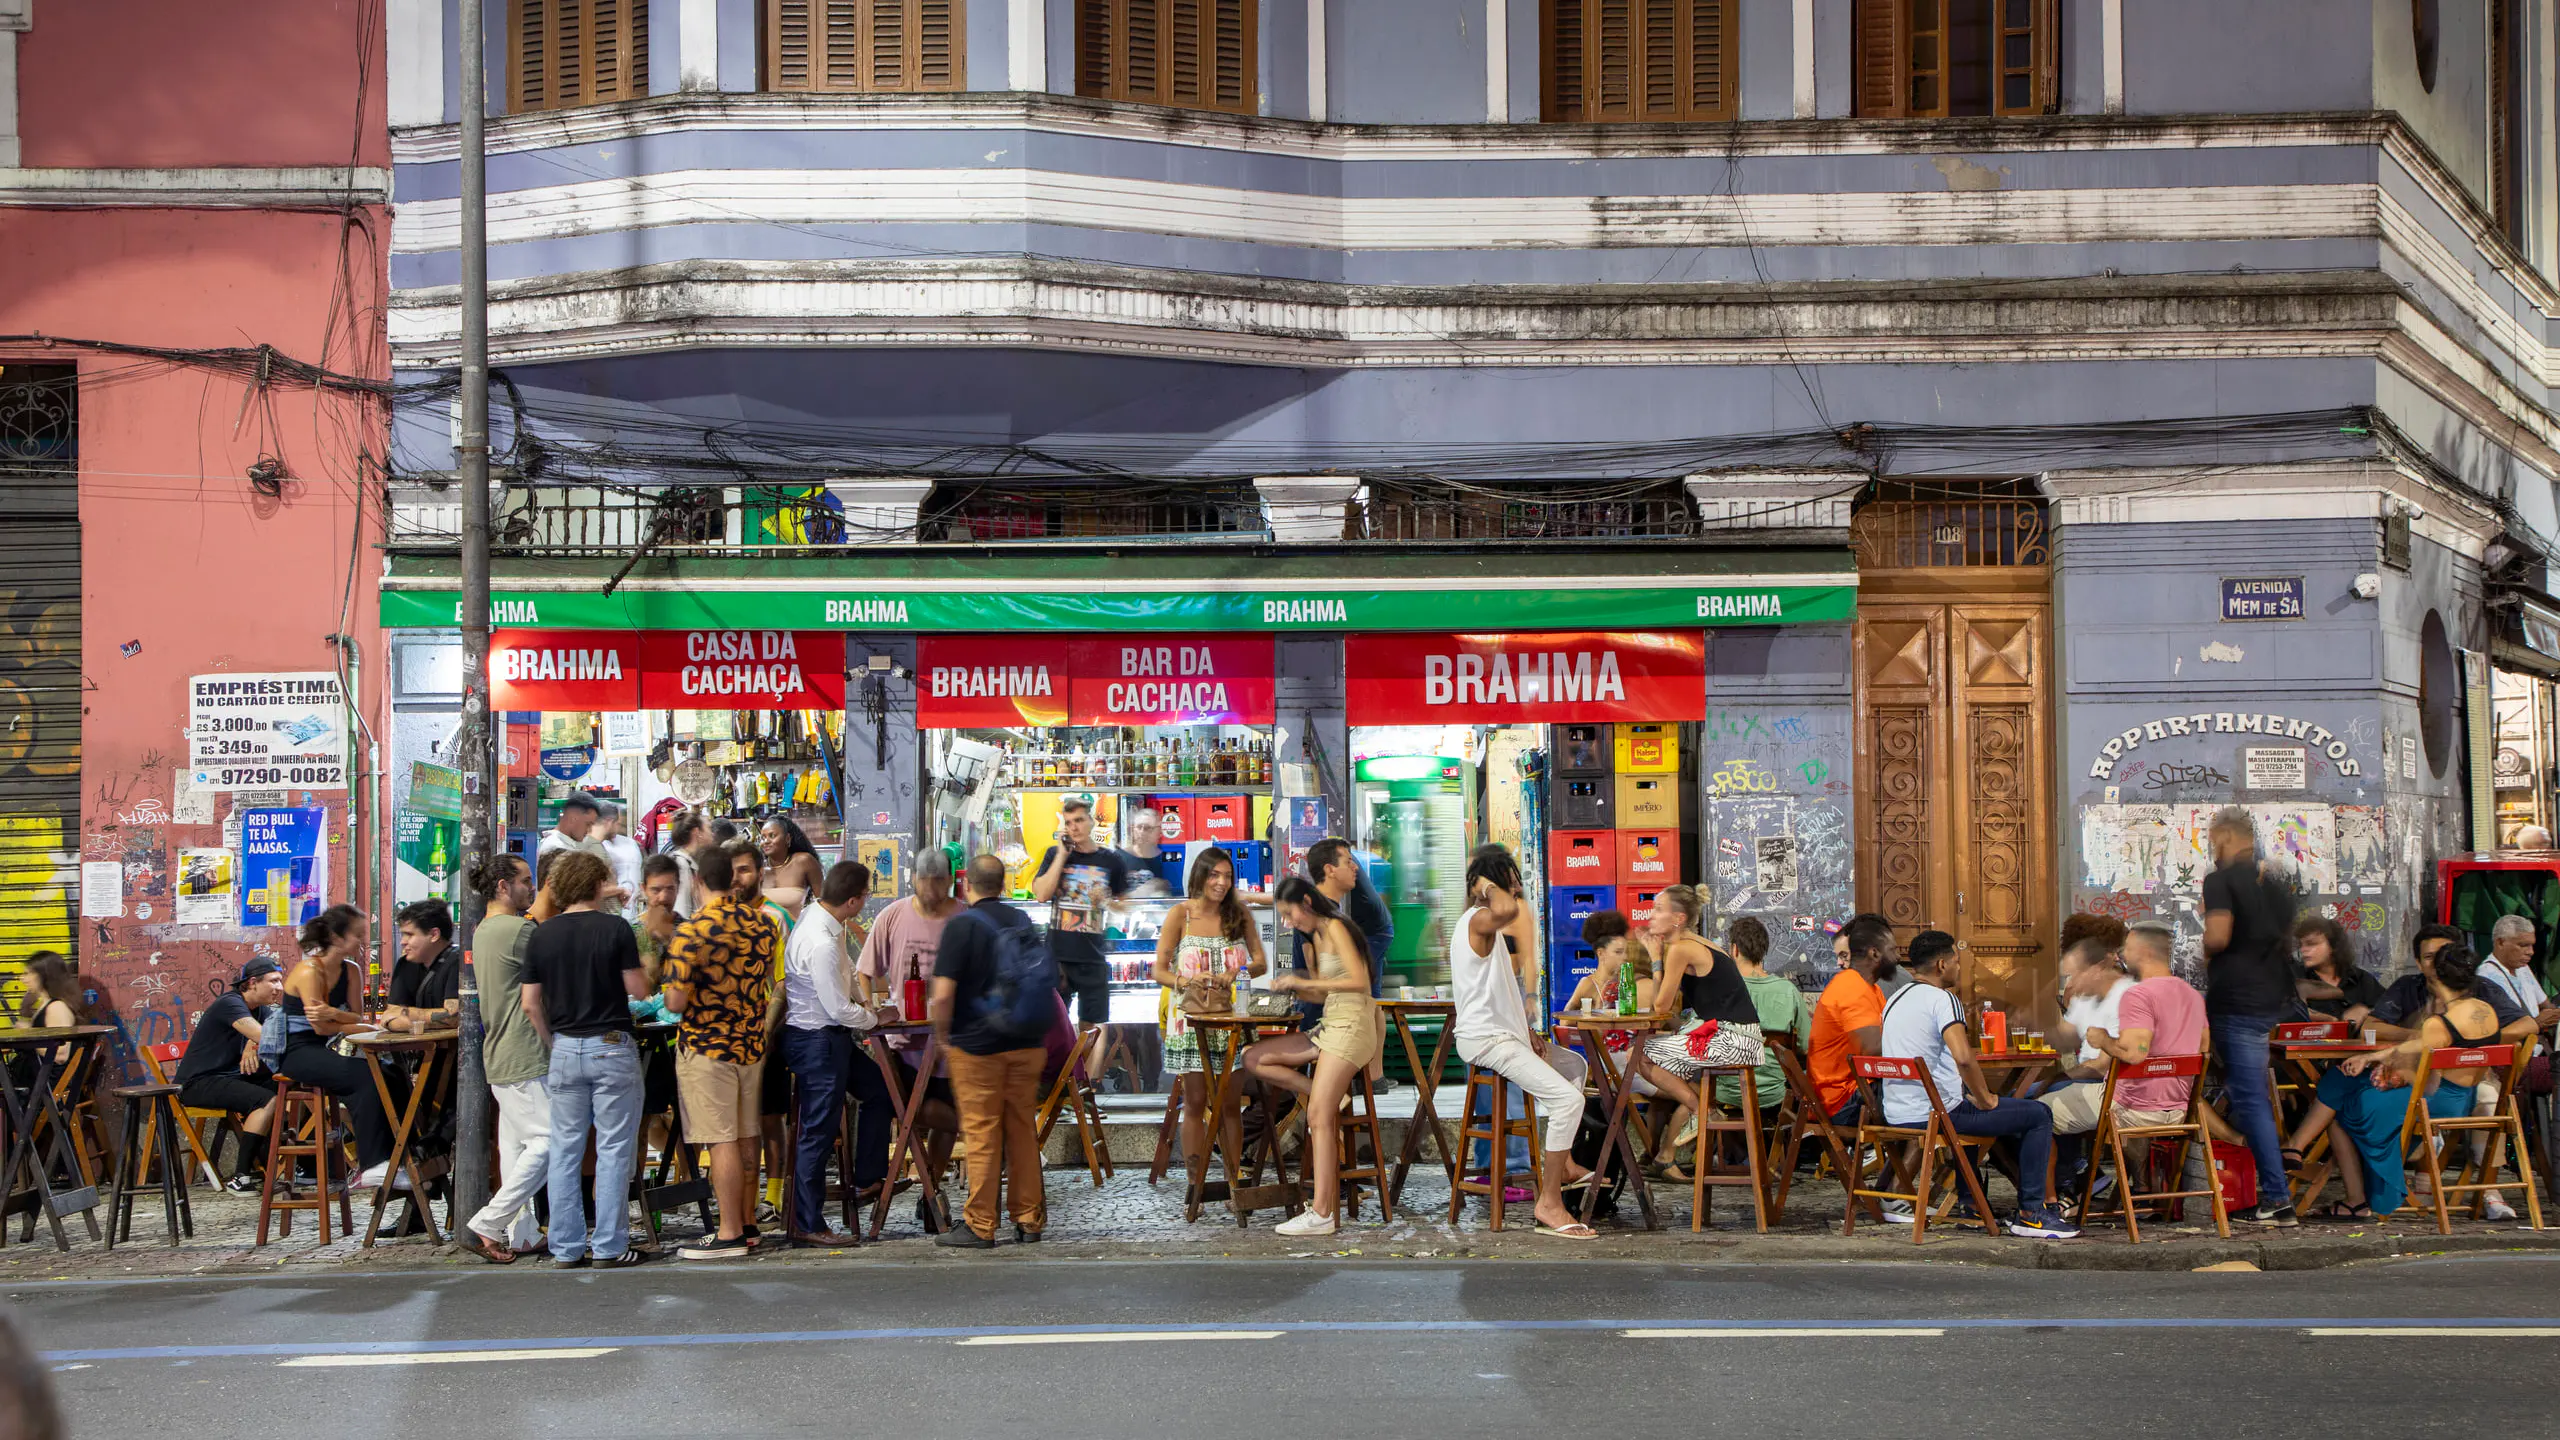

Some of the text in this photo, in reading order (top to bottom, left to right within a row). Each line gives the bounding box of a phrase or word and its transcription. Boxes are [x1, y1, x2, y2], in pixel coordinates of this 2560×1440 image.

[1936, 526, 1962, 542] 108
[2234, 582, 2292, 594] AVENIDA
[454, 600, 538, 622] BHMA
[826, 600, 908, 622] BRAHMA
[1264, 600, 1346, 622] BRAHMA
[1697, 596, 1781, 618] BRAHMA
[2229, 598, 2260, 616] MEM
[2264, 602, 2277, 615] DE
[687, 630, 797, 662] CASA DA
[504, 649, 622, 680] BRAHMA
[1121, 647, 1214, 676] BAR DA
[682, 664, 804, 702] CACHAÇA
[932, 666, 1052, 698] BRAHMA
[1425, 651, 1625, 705] BRAHMA
[196, 680, 339, 696] EMPRÉSTIMO
[196, 694, 340, 707] NO CARTÃO DE CRÉDITO
[1108, 682, 1228, 720] CACHAÇA
[212, 717, 267, 732] 3.000,00
[201, 740, 268, 755] R$ 349,00
[2088, 713, 2360, 780] APPARTAMENTOS
[195, 757, 227, 766] EMPRESTAMOS
[228, 757, 251, 765] QUALQUER
[272, 755, 305, 764] DINHEIRO
[318, 755, 340, 764] HORA!
[221, 768, 341, 784] 97290-0082
[249, 814, 295, 826] RED BULL
[1207, 818, 1233, 828] BRAHMA
[249, 829, 261, 840] TE
[262, 826, 277, 840] DÁ
[249, 842, 292, 854] AAASAS.
[1566, 856, 1600, 867] BRAHMA
[1633, 862, 1664, 872] BRAHMA
[1570, 911, 1593, 919] amb
[1632, 909, 1652, 920] BRAH
